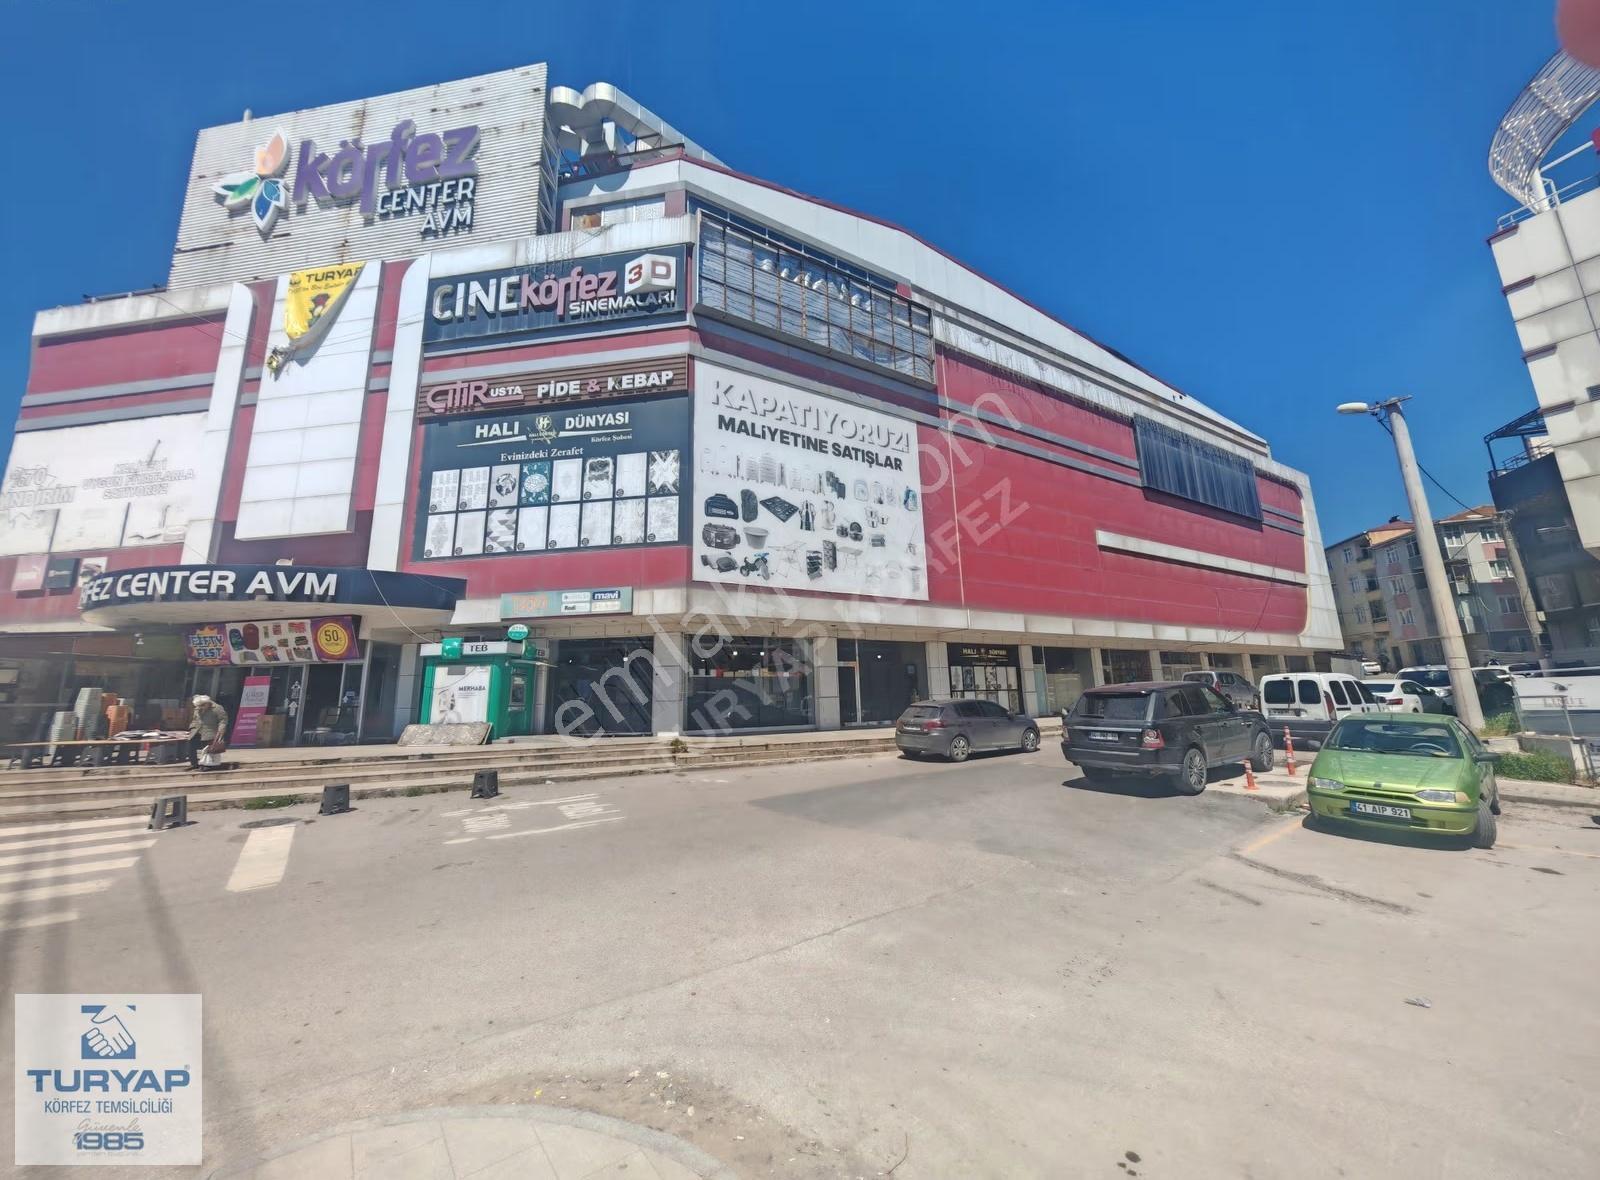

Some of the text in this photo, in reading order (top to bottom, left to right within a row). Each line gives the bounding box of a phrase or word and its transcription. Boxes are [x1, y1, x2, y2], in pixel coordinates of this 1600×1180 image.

[293, 119, 481, 214] körfez
[377, 178, 475, 214] CENTER
[421, 207, 473, 233] AVM
[490, 385, 522, 397] USTA
[537, 381, 581, 399] PİDE
[586, 378, 600, 392] &
[607, 370, 674, 391] KEBAP
[475, 421, 520, 438] HALI
[565, 411, 630, 430] DÜNYASI
[500, 447, 584, 462] Evinizdeki Zerafet
[718, 414, 904, 472] MALİYETİNE SATIŞLAR
[116, 570, 236, 597] CENTER
[246, 571, 337, 596] AVM
[594, 591, 619, 600] mavi
[324, 629, 339, 641] 50
[469, 644, 488, 652] TEB
[1371, 806, 1387, 814] AIP
[1391, 808, 1409, 817] 921
